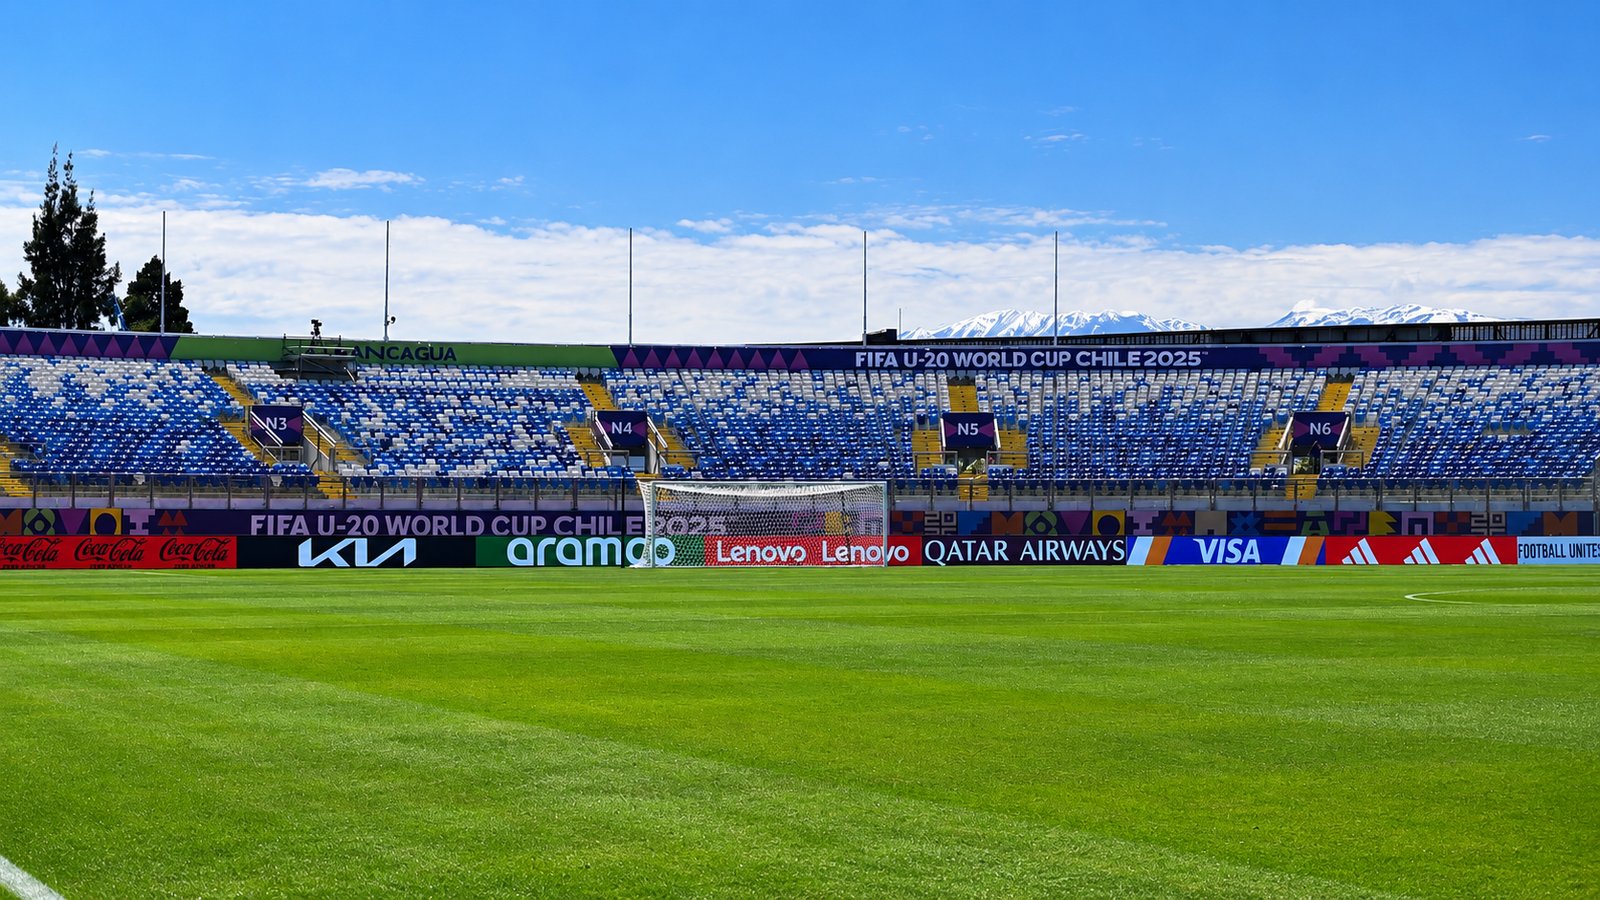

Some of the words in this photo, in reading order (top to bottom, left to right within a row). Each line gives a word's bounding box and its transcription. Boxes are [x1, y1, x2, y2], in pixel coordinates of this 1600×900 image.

[350, 345, 457, 361] ANCAGUA
[855, 351, 898, 368] FIFA
[904, 351, 949, 368] U-20
[953, 351, 1027, 368] WORLD
[1030, 351, 1072, 367] CUP
[1075, 350, 1141, 367] CHILE
[1143, 350, 1202, 367] 2025
[265, 417, 288, 430] N3
[611, 421, 633, 435] N4
[957, 422, 979, 436] N5
[1309, 422, 1332, 435] N6
[250, 514, 310, 536] FIFA
[317, 514, 380, 536] U-20
[384, 515, 485, 536] WORLD
[490, 515, 547, 536] CUP
[553, 515, 644, 536] CHILE
[0, 537, 62, 562] ca-Cola
[74, 537, 149, 562] Coca-Cola
[159, 537, 232, 562] Coca-Cola
[506, 537, 676, 567] aramco
[716, 540, 807, 563] Lenovo
[822, 540, 910, 563] Lenovo
[924, 540, 1010, 566] QATAR
[1019, 540, 1126, 562] AIRWAYS
[1192, 538, 1262, 564] VISA
[1518, 543, 1567, 559] FOOTBALL
